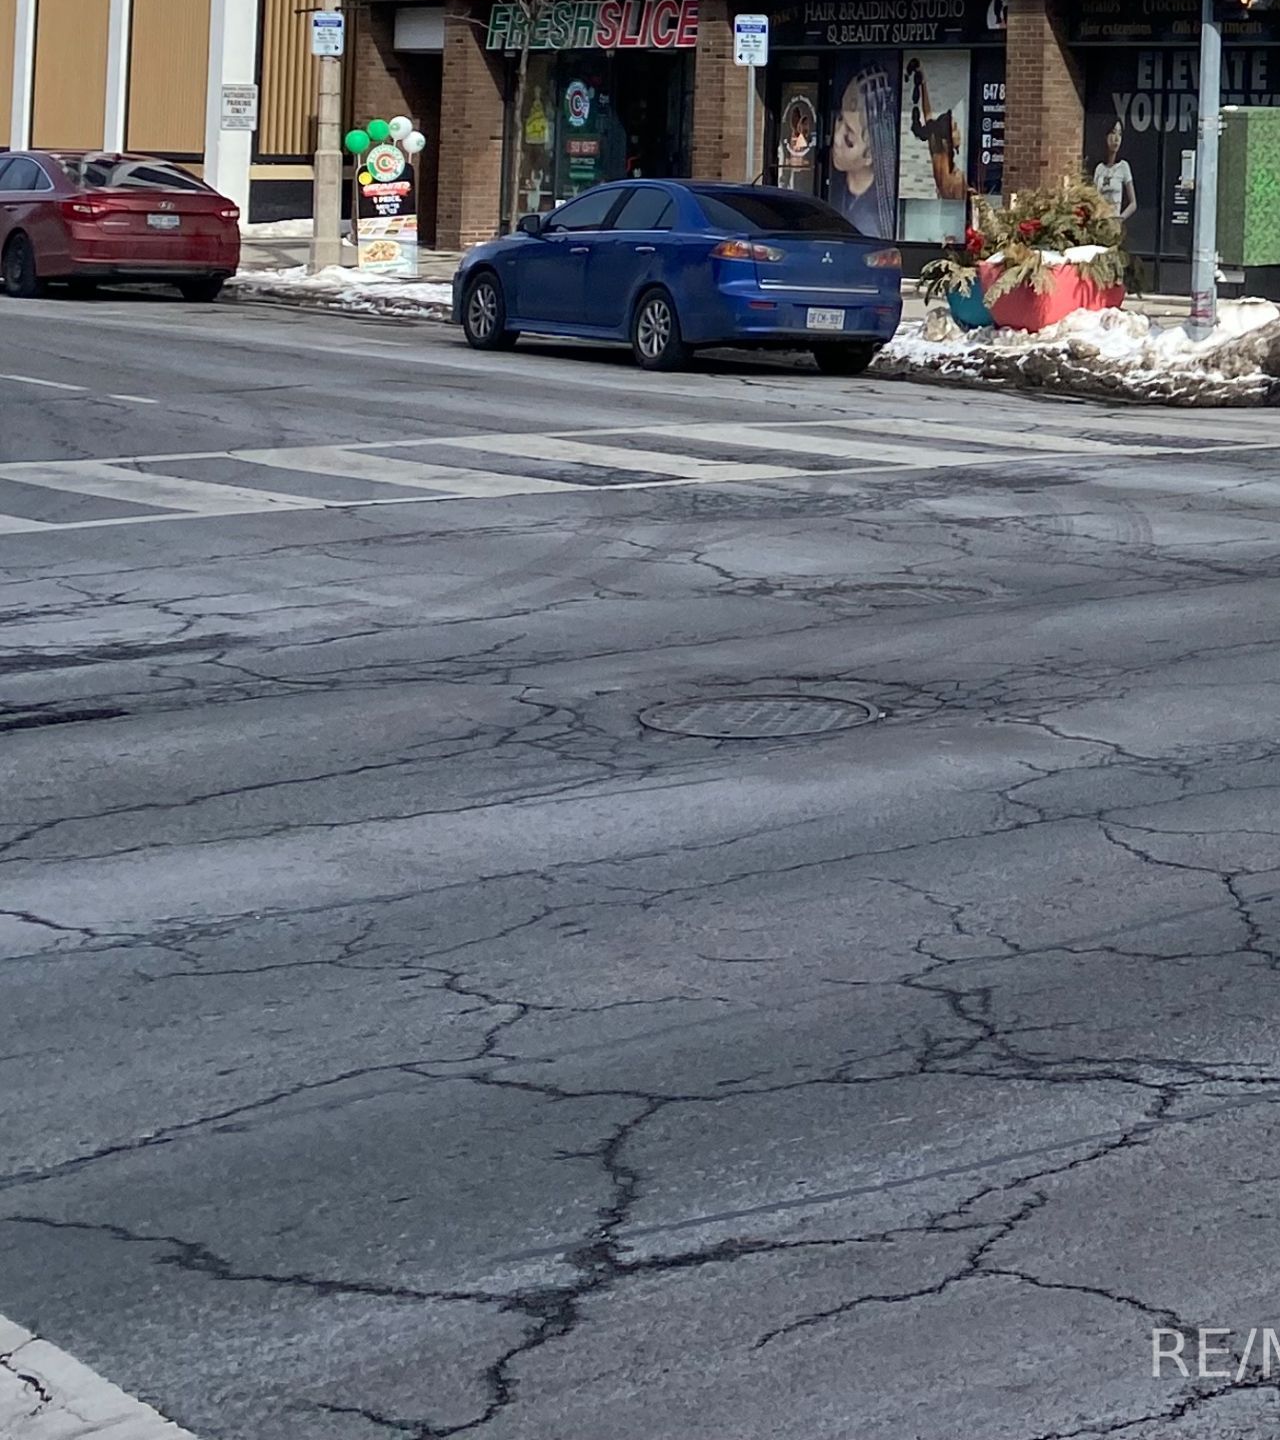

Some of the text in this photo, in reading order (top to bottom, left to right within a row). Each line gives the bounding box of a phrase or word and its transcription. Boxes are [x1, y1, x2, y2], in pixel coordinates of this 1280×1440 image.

[804, 0, 836, 24] HAIR
[838, 0, 907, 21] BRAIDING
[840, 24, 890, 43] BEAUTY
[892, 22, 939, 44] SUPPLY
[983, 83, 999, 100] 647
[1111, 92, 1198, 133] YOUR
